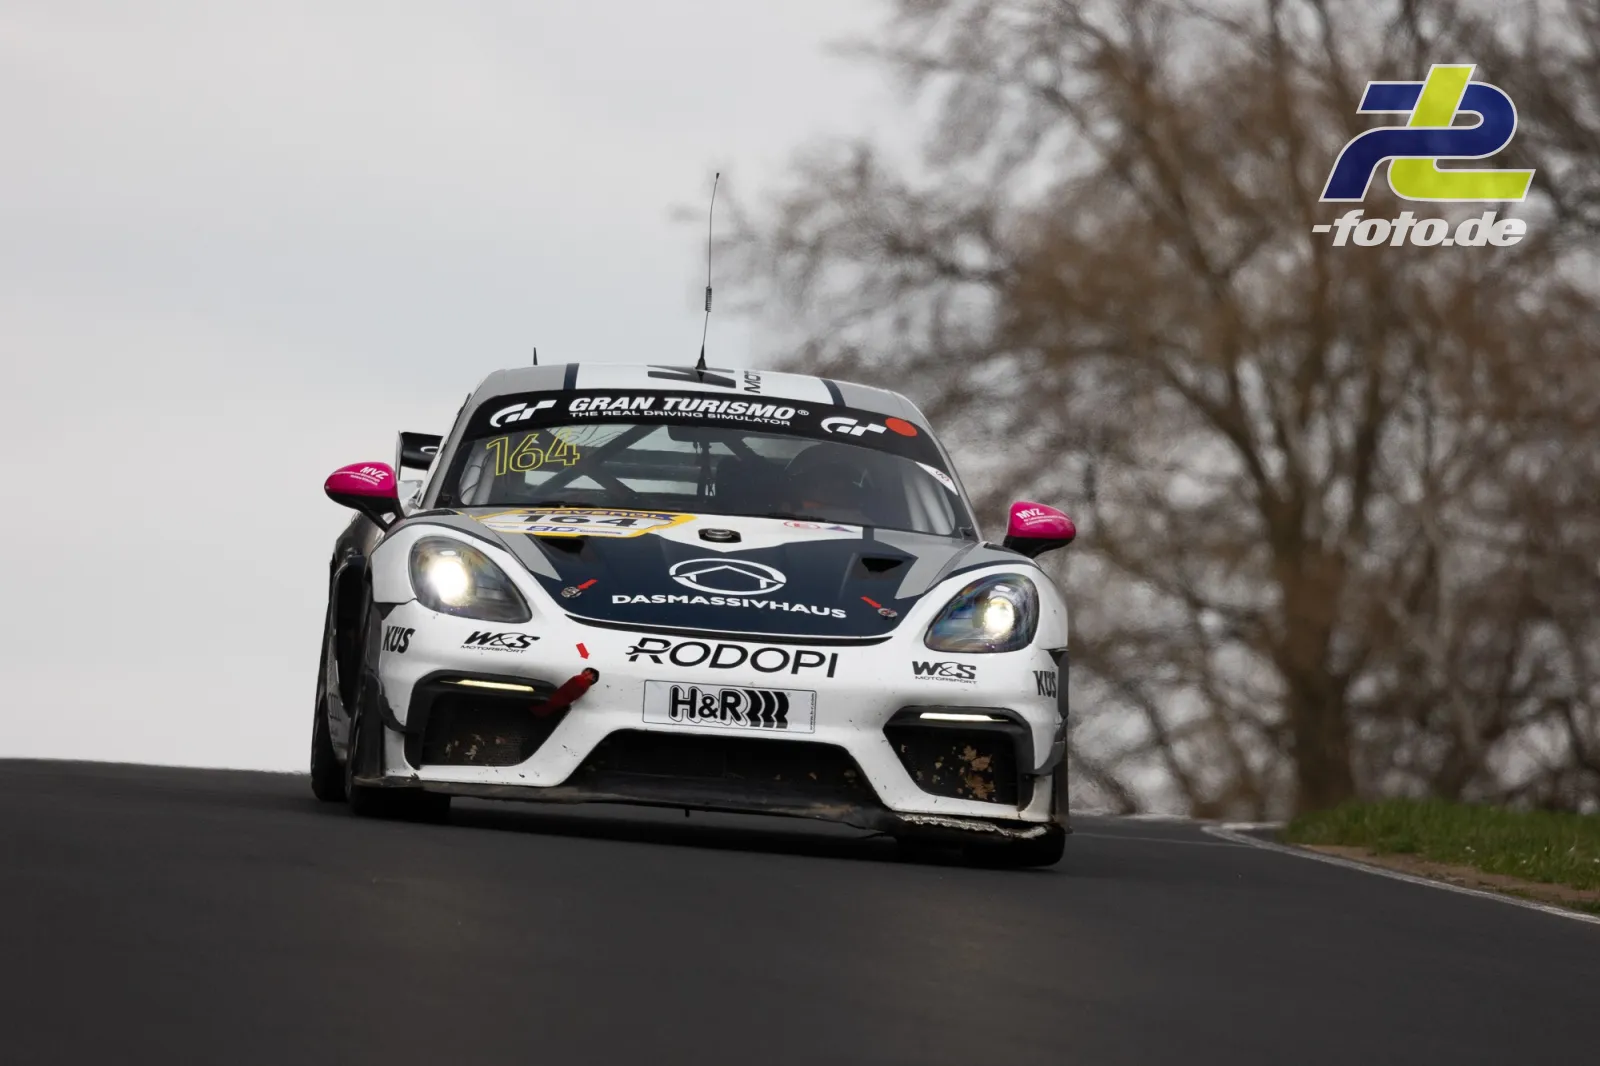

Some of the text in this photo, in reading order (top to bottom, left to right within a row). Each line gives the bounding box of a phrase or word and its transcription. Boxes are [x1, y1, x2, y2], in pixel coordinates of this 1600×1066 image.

[569, 397, 655, 412] GRAN
[644, 410, 704, 418] DRIVING
[707, 412, 791, 426] SIMULATOR
[486, 428, 580, 476] 164
[360, 466, 389, 480] MVZ
[517, 514, 638, 528] 164
[1015, 508, 1045, 520] MVZ
[611, 594, 847, 619] DASMASSIVHAUS
[463, 630, 541, 649] W&S
[460, 645, 527, 654] MOTORSPORT
[625, 637, 839, 678] RODOPI
[912, 660, 977, 680] W&S
[914, 675, 978, 684] MOTORSPORT
[669, 685, 748, 726] H&R
